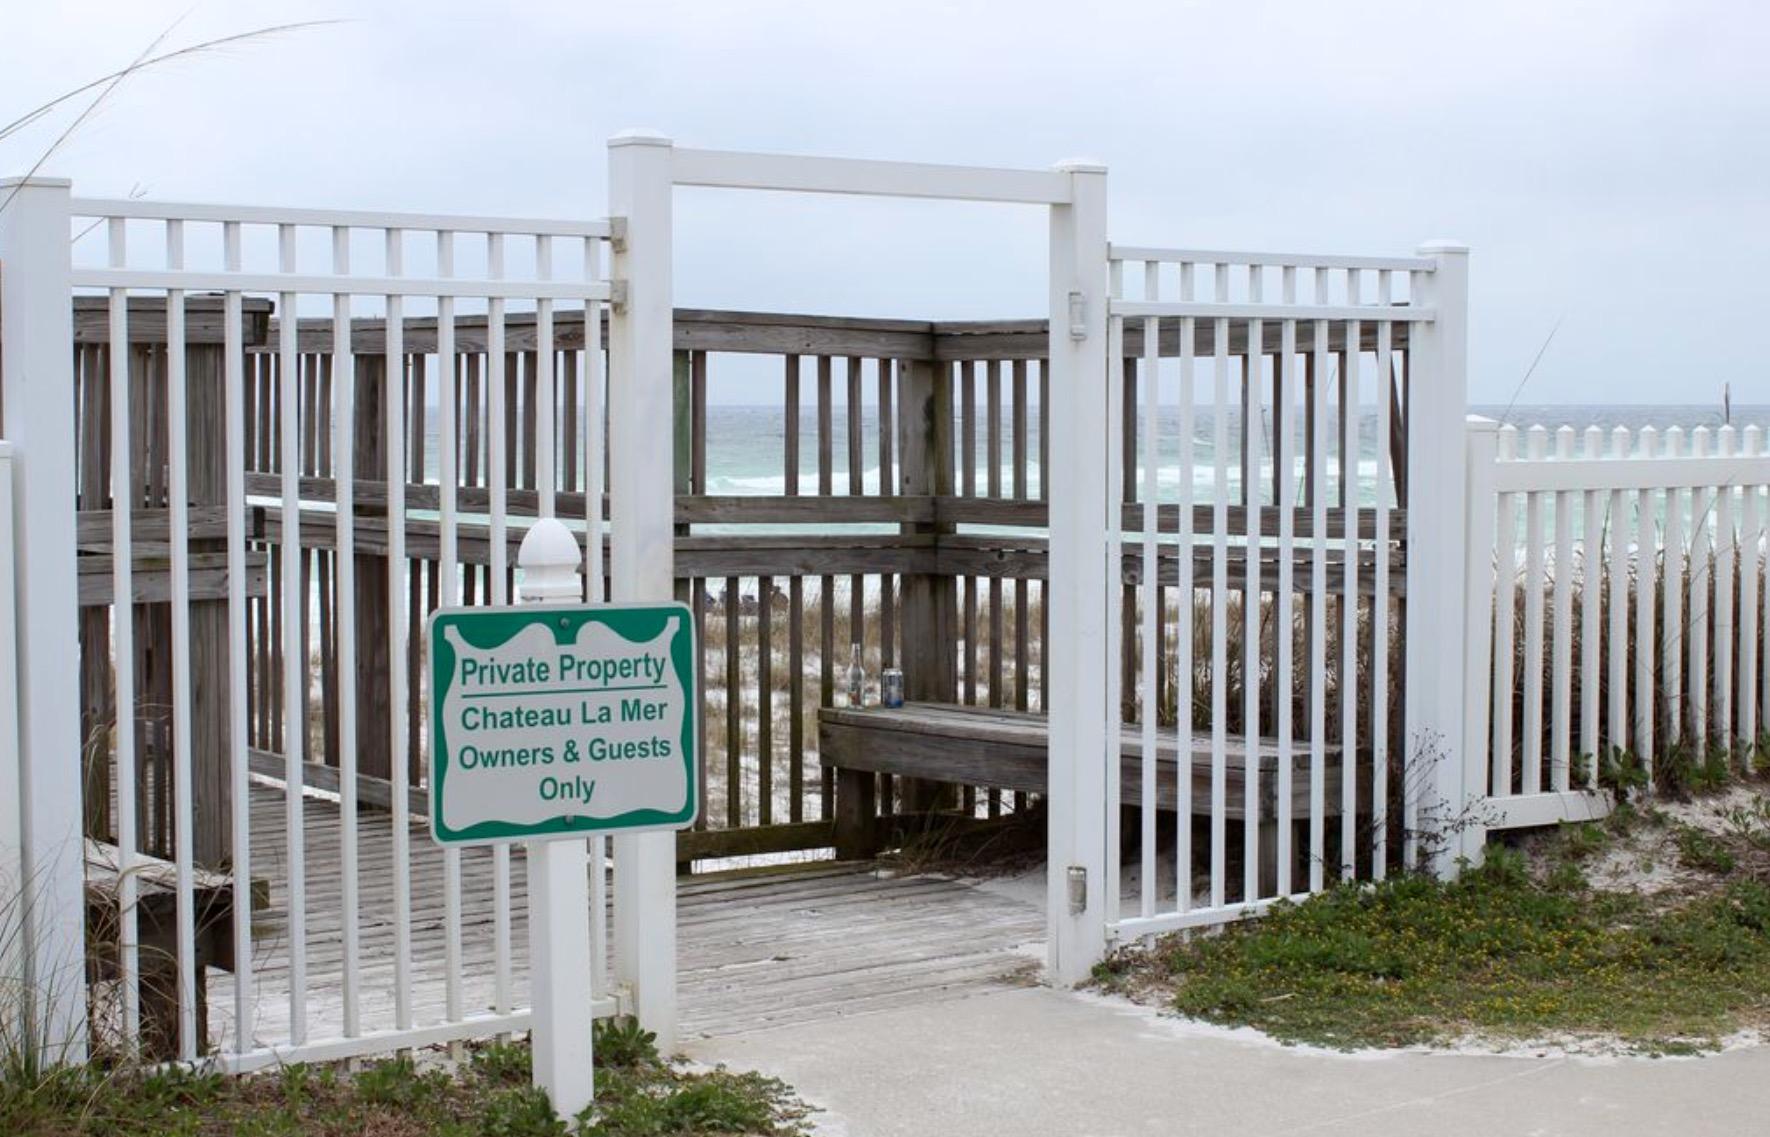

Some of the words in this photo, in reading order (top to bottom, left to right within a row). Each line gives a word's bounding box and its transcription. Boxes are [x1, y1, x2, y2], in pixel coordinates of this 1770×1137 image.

[461, 657, 549, 685] Private
[559, 654, 666, 685] Property
[461, 704, 571, 730] Chateau
[581, 703, 611, 724] La
[621, 698, 668, 722] Mer
[459, 744, 554, 769] Owners
[563, 740, 580, 763] &
[588, 737, 671, 761] Guests
[539, 776, 595, 804] Only
